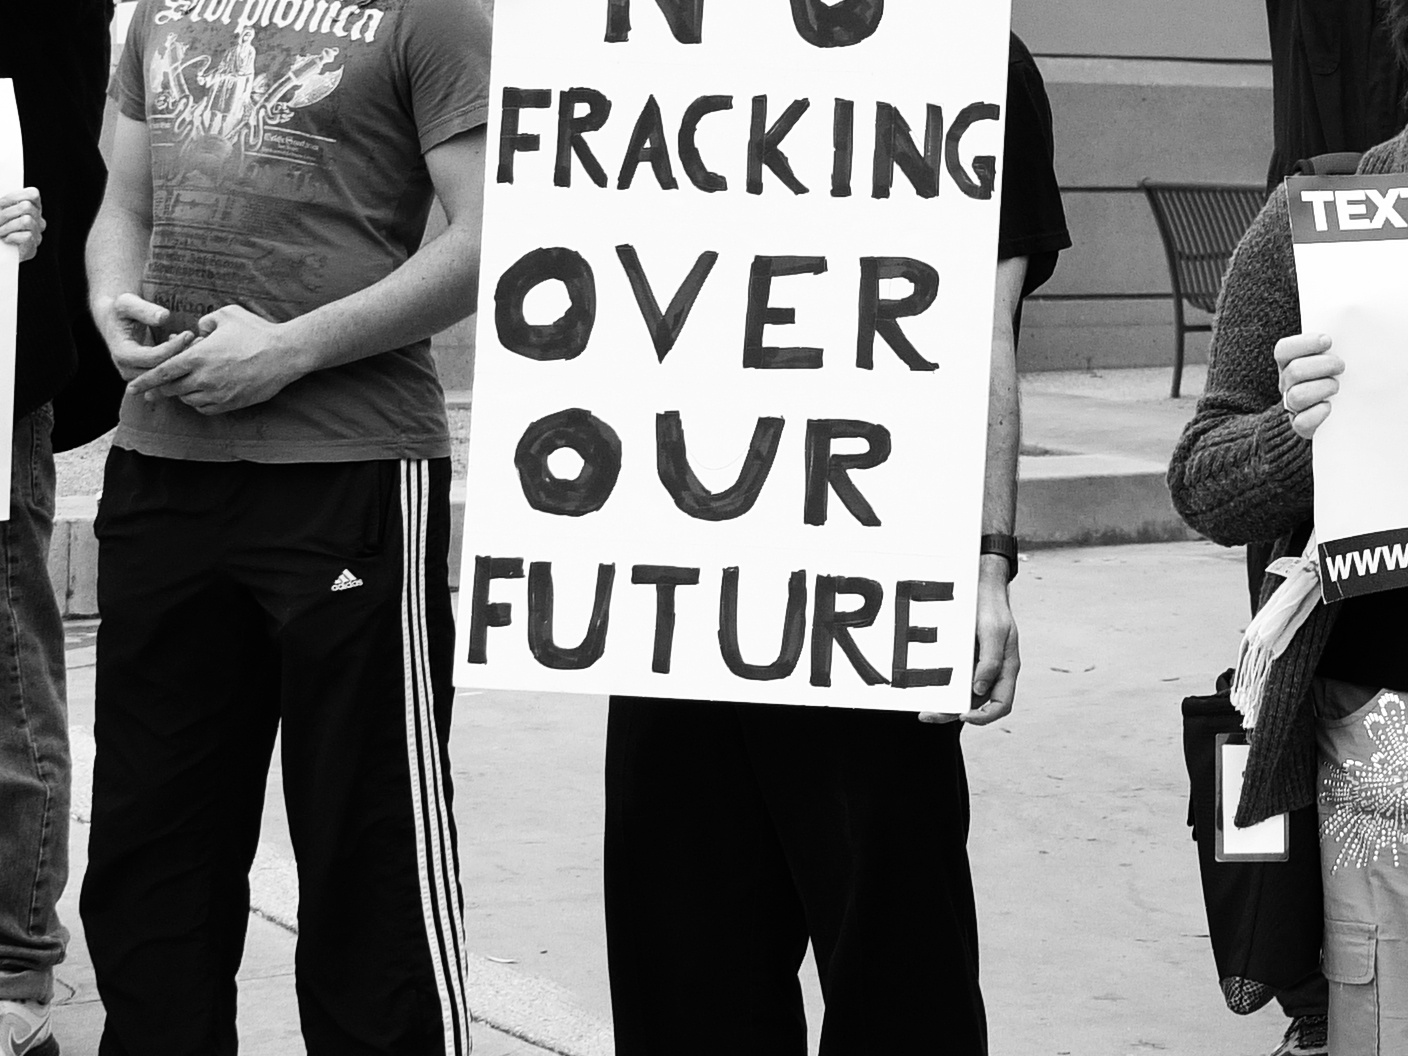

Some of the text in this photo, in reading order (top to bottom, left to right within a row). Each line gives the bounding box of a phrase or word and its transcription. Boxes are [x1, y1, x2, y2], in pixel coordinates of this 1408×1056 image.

[497, 87, 1000, 201] FRACKING
[494, 244, 940, 371] OVER
[514, 408, 892, 527] OUR
[468, 555, 954, 689] FUTURE
